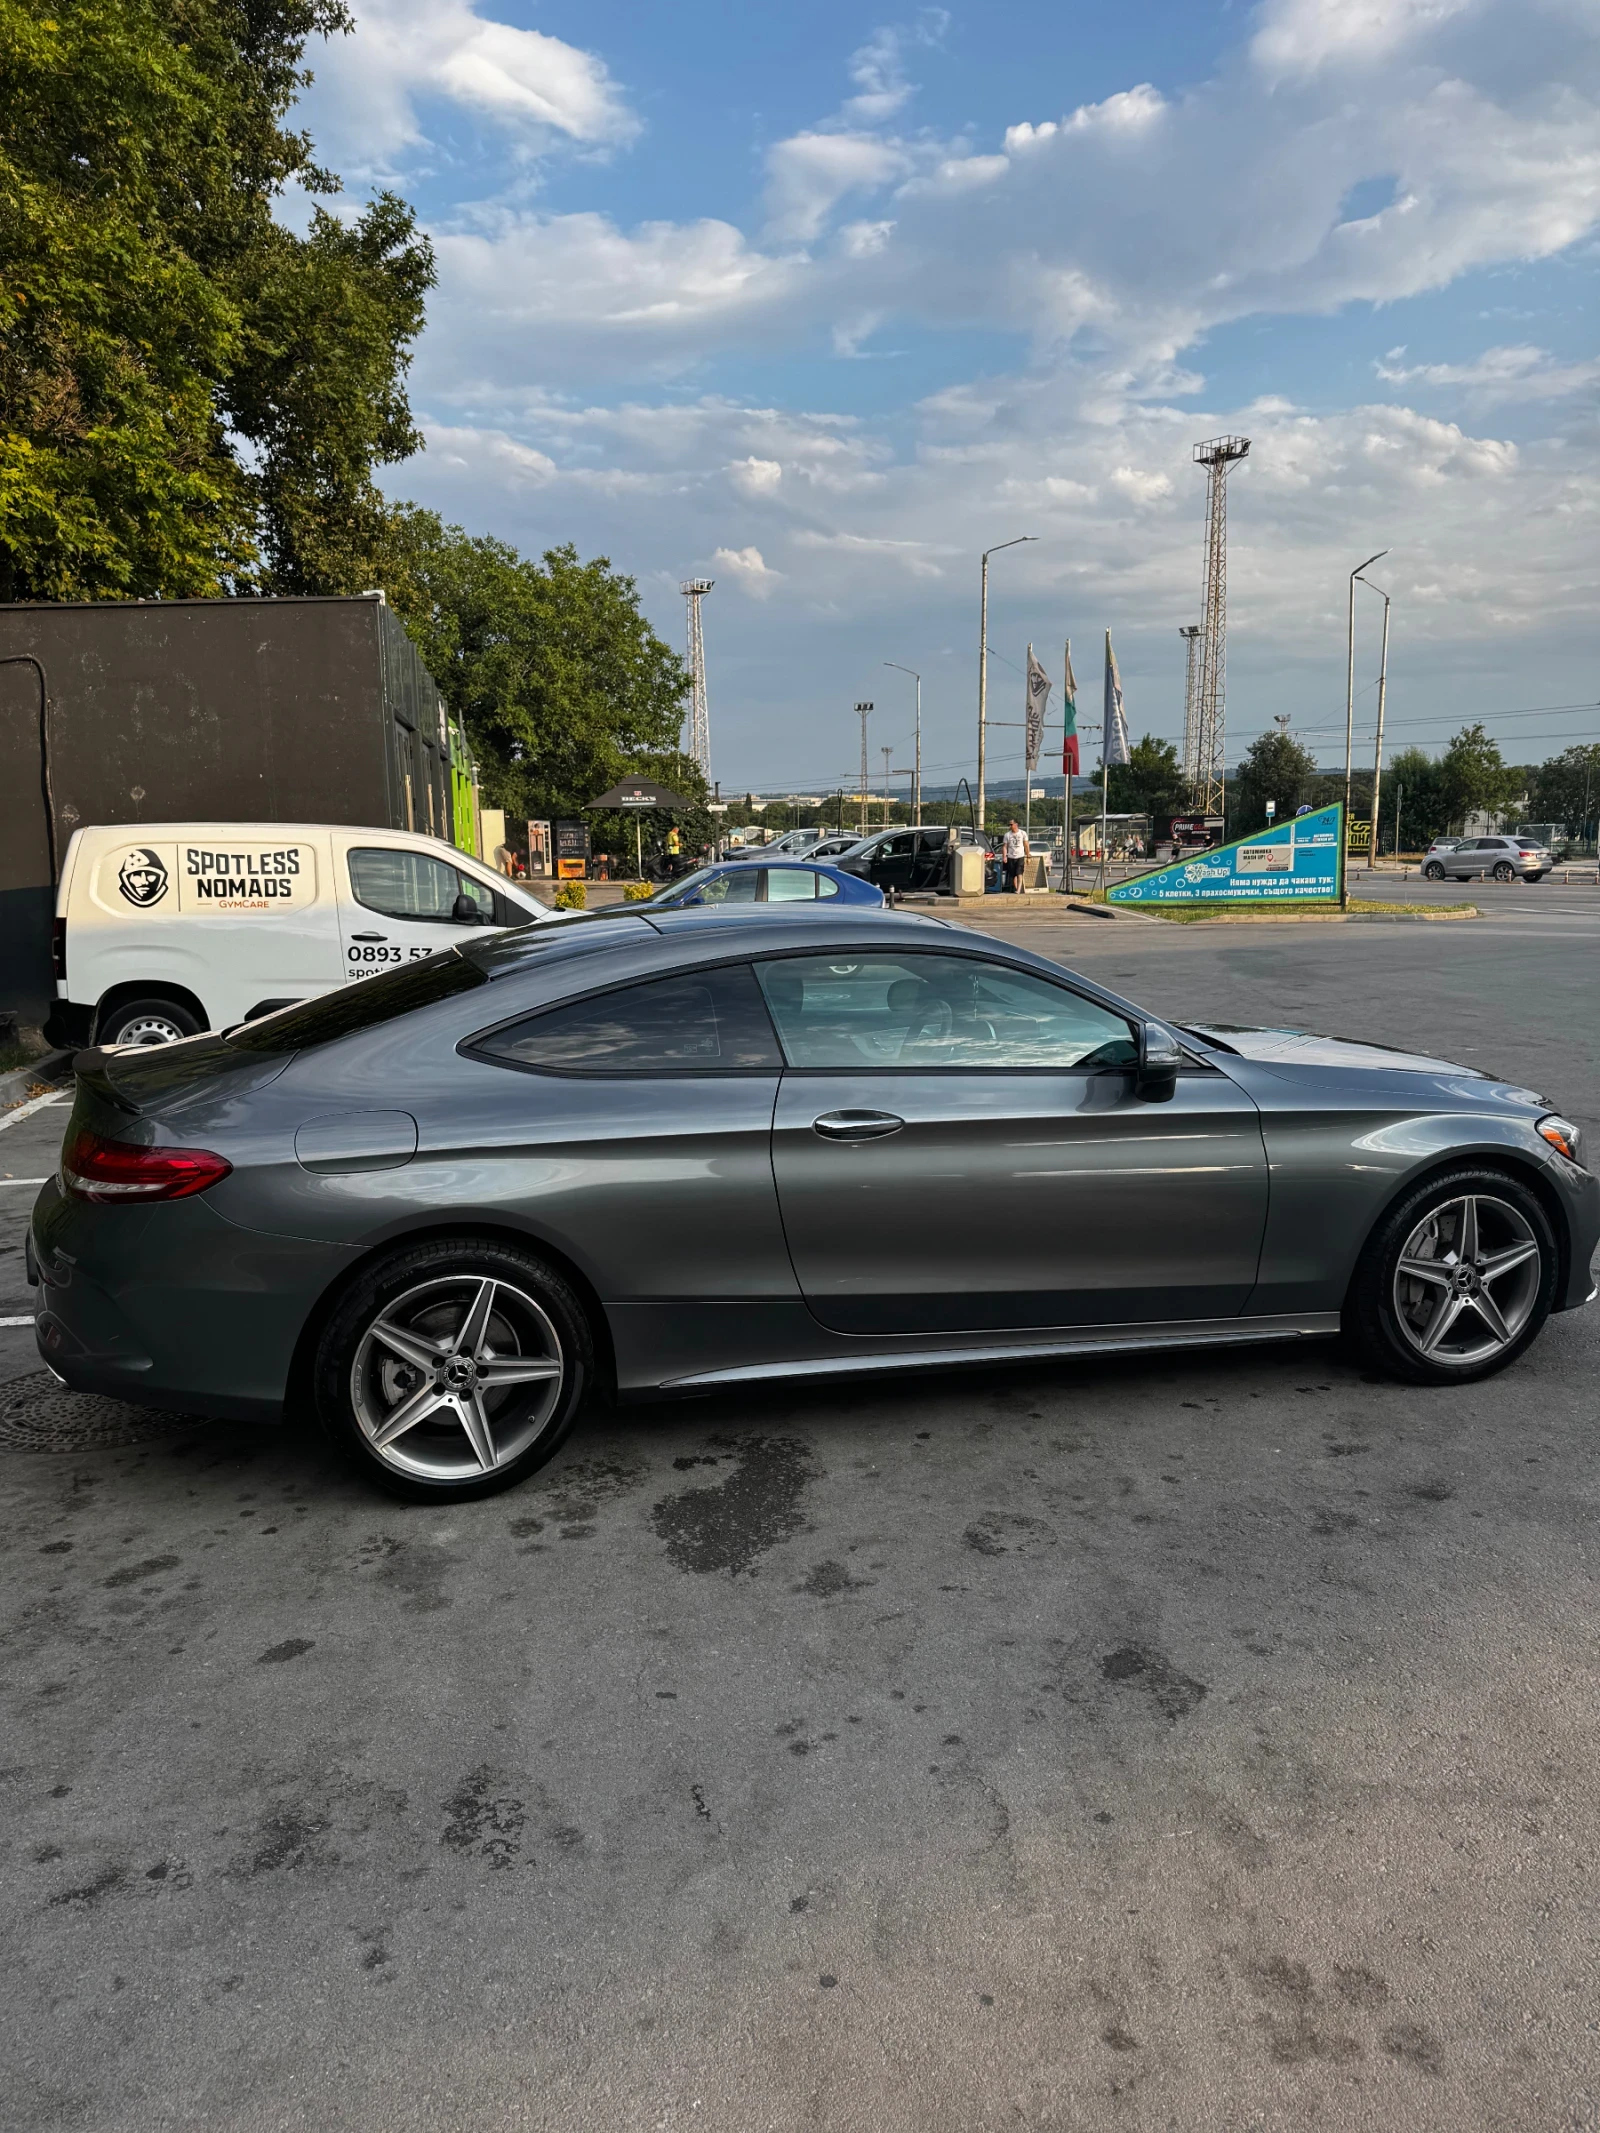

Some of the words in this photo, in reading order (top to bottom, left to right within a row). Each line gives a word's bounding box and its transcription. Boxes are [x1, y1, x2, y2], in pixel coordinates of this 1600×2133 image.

[187, 848, 300, 875] SPOTLESS
[197, 878, 292, 898] NOMADS
[1252, 878, 1277, 888] нужда
[1279, 878, 1289, 887] да
[1291, 877, 1316, 886] чакаш
[1159, 890, 1164, 898] 5
[1195, 889, 1200, 897] 3
[1263, 887, 1294, 896] същото
[347, 946, 402, 963] 0893
